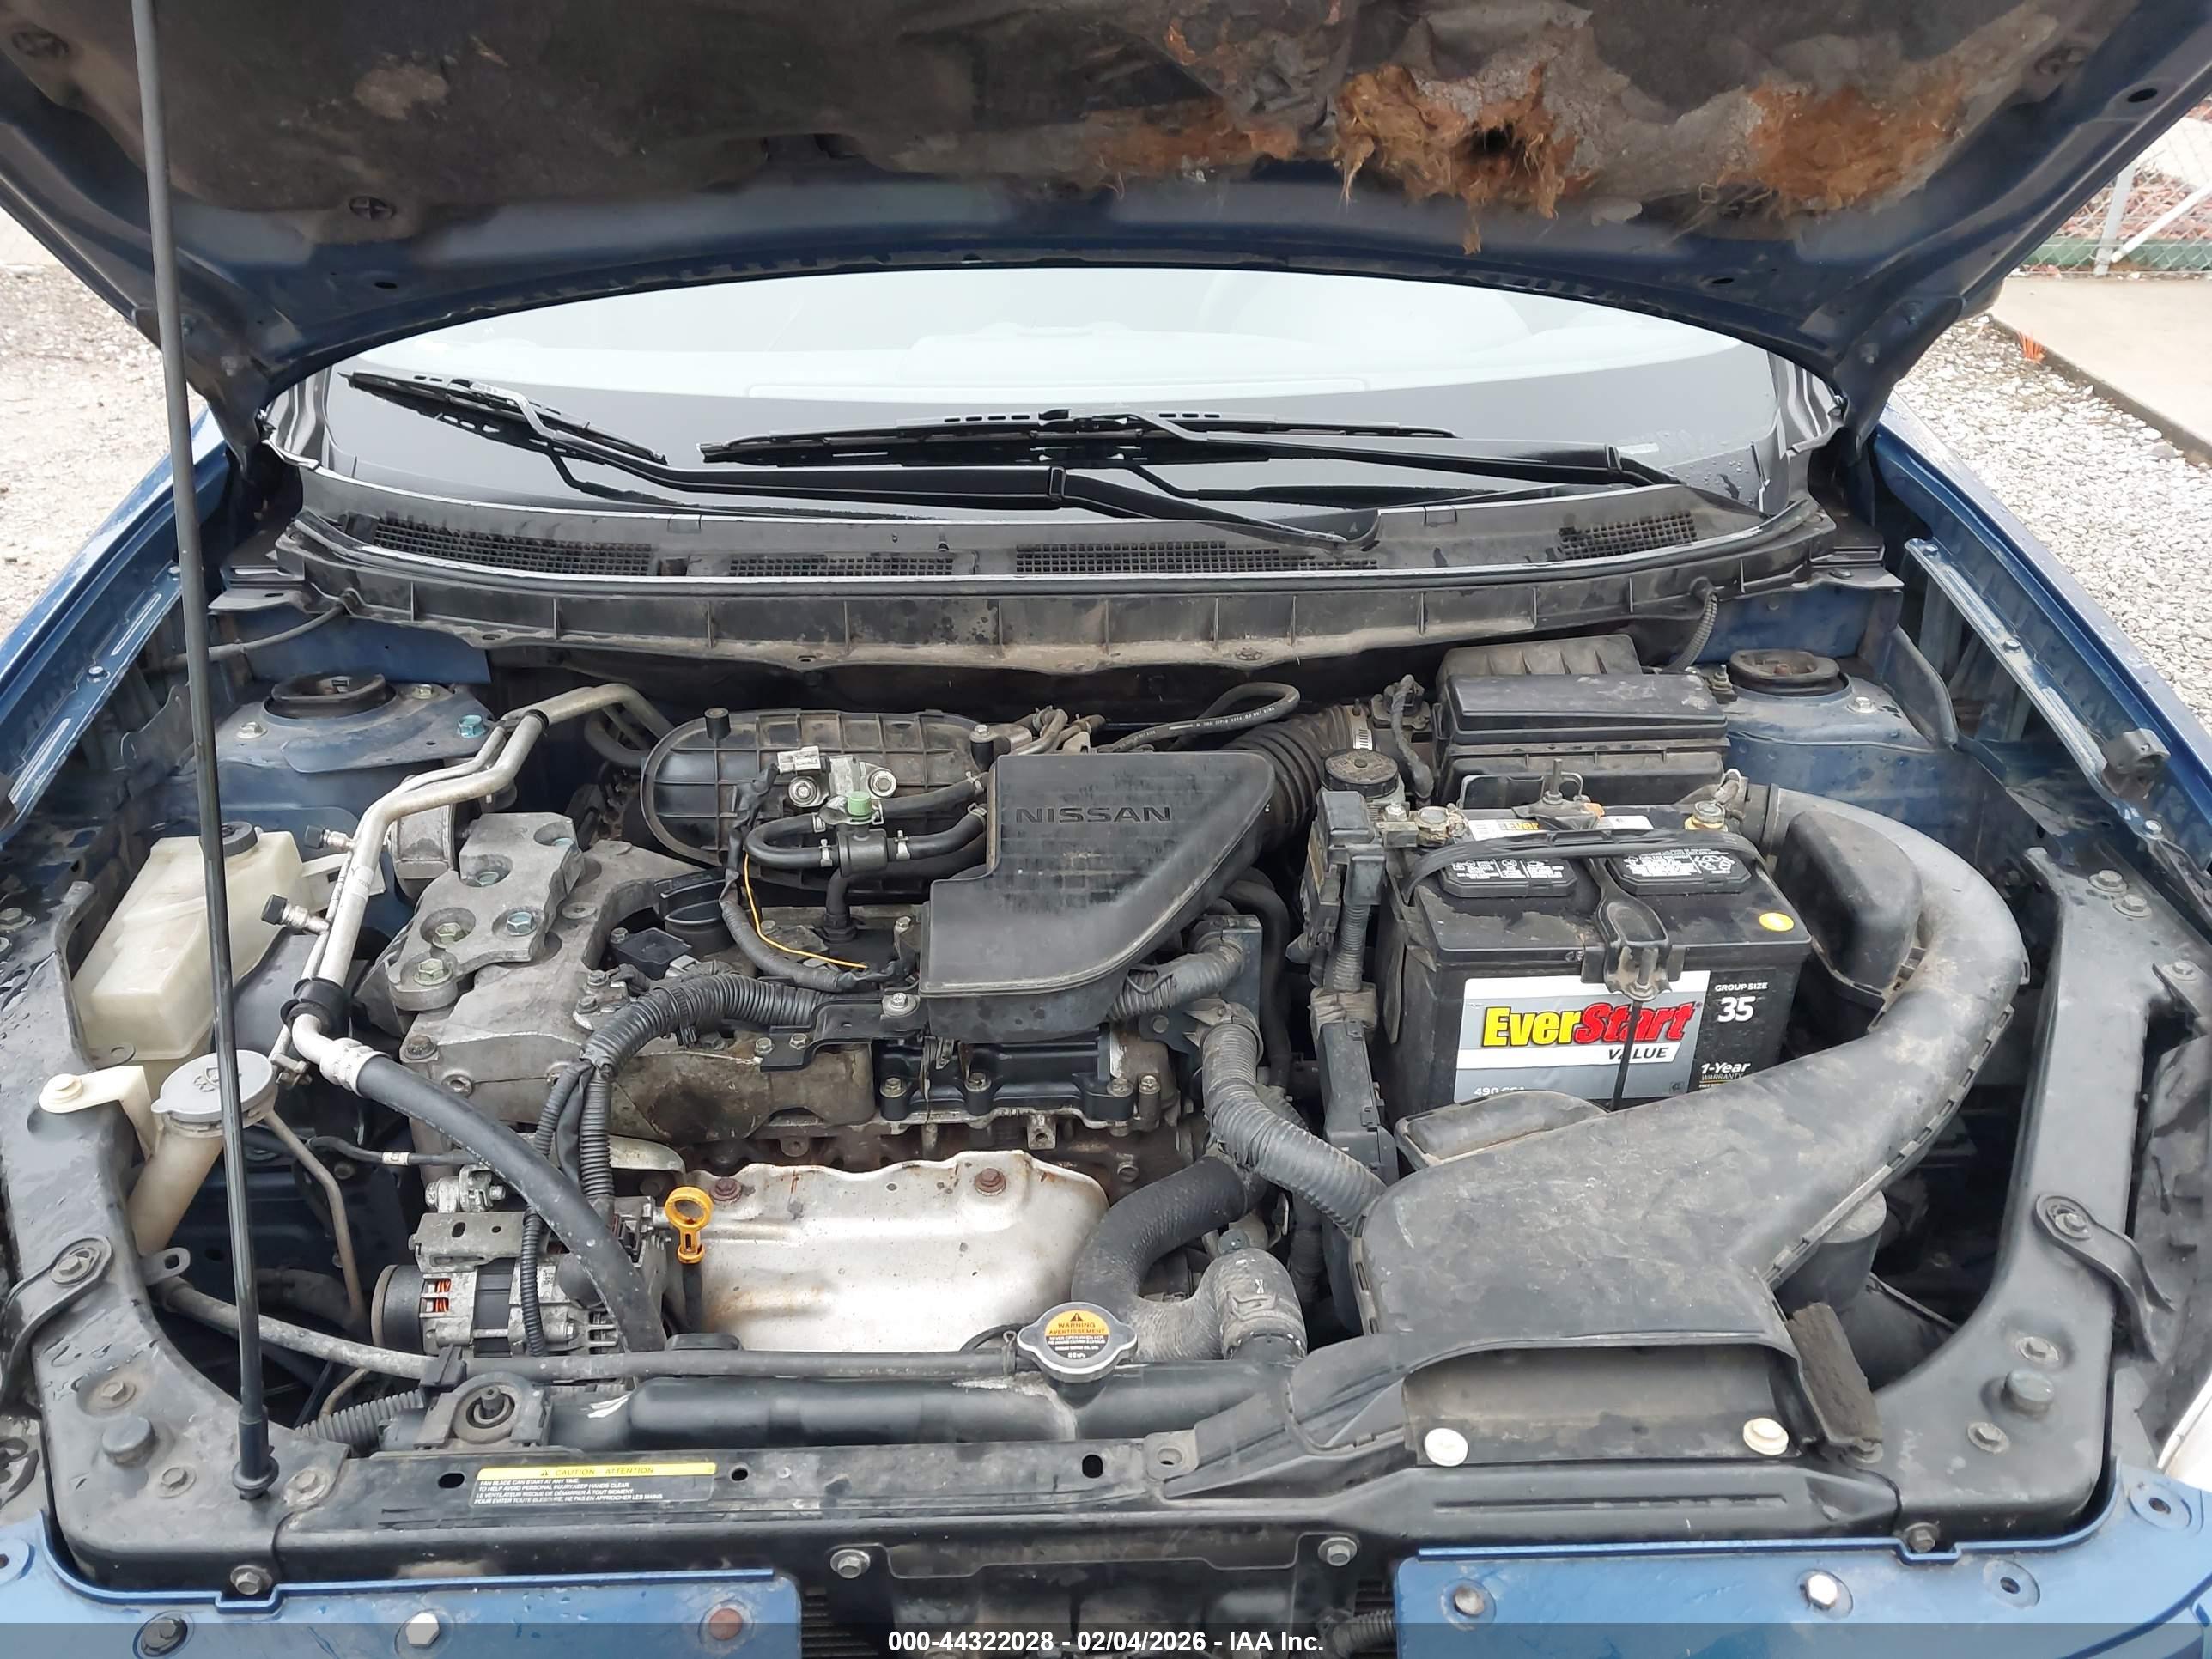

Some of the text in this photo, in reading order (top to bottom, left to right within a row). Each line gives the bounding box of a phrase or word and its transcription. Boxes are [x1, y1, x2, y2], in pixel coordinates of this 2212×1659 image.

[1016, 806, 1173, 823] NISSAN
[1715, 981, 1769, 992] GROUP SIZE
[1717, 996, 1756, 1023] 35
[1482, 1002, 1697, 1048] EverStart
[1608, 1047, 1668, 1060] VLUE
[1701, 1062, 1751, 1074] 1-Year
[1474, 1087, 1499, 1096] 490
